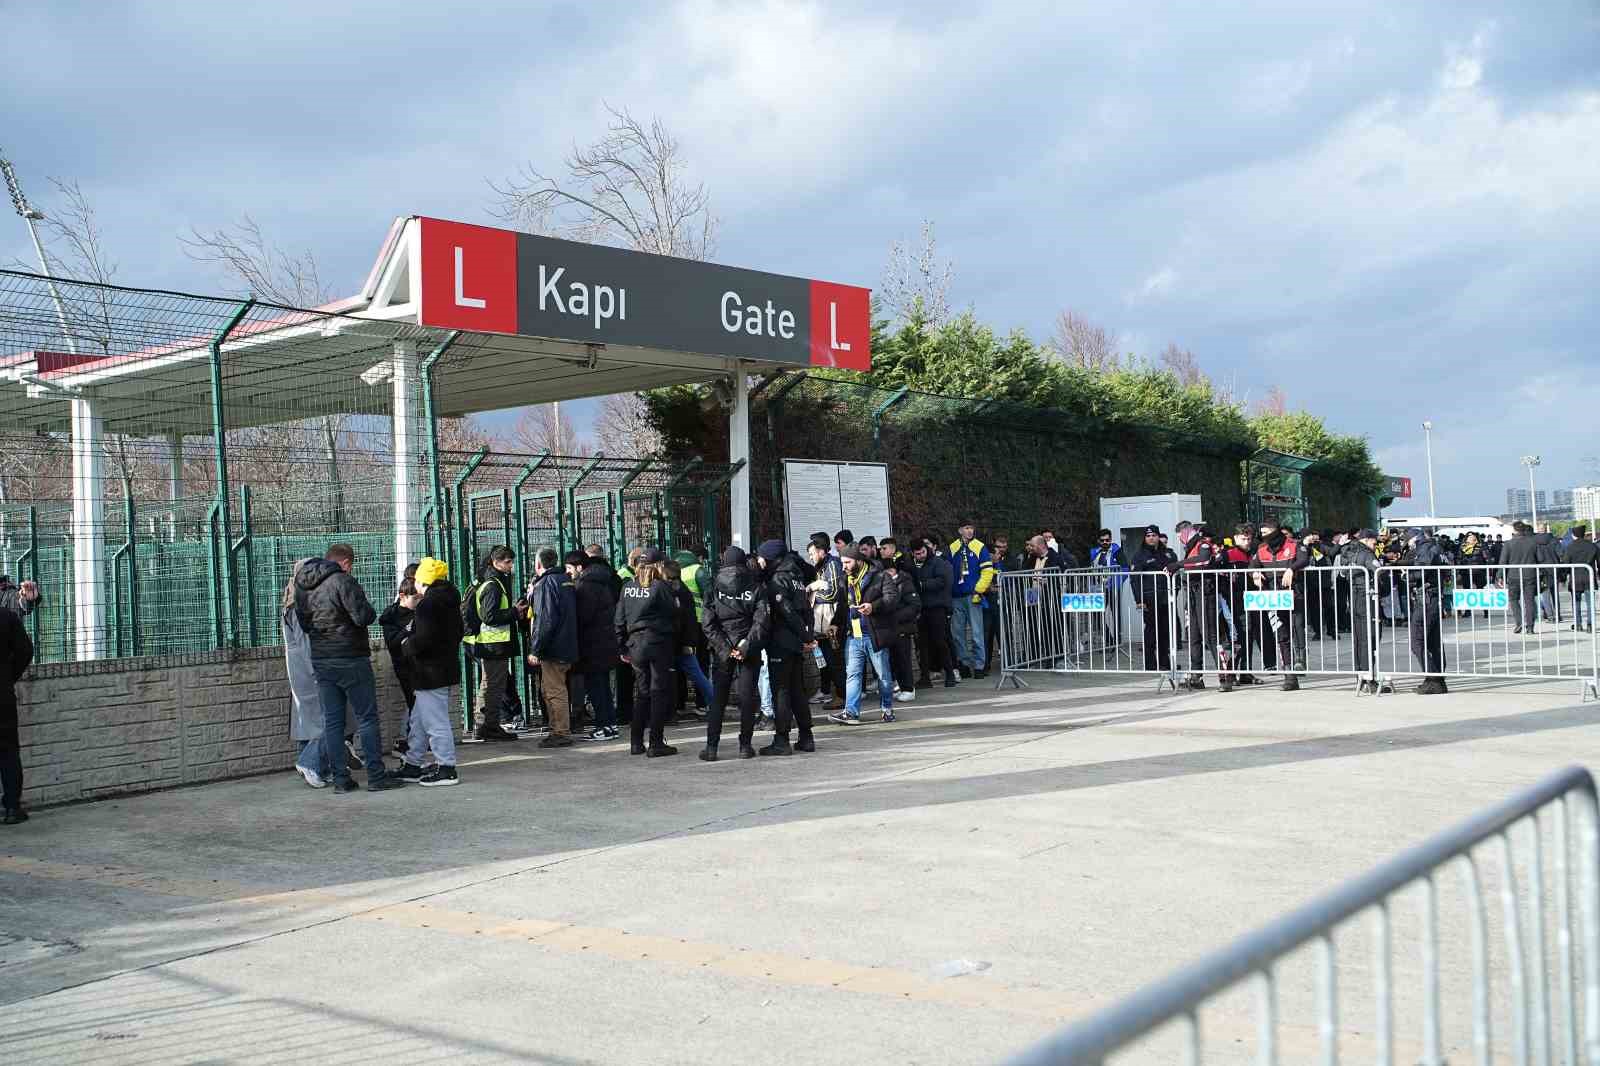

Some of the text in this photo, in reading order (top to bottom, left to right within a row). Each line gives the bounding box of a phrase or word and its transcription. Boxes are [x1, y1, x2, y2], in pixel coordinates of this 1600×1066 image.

[453, 246, 851, 351] L Kapı Gate L
